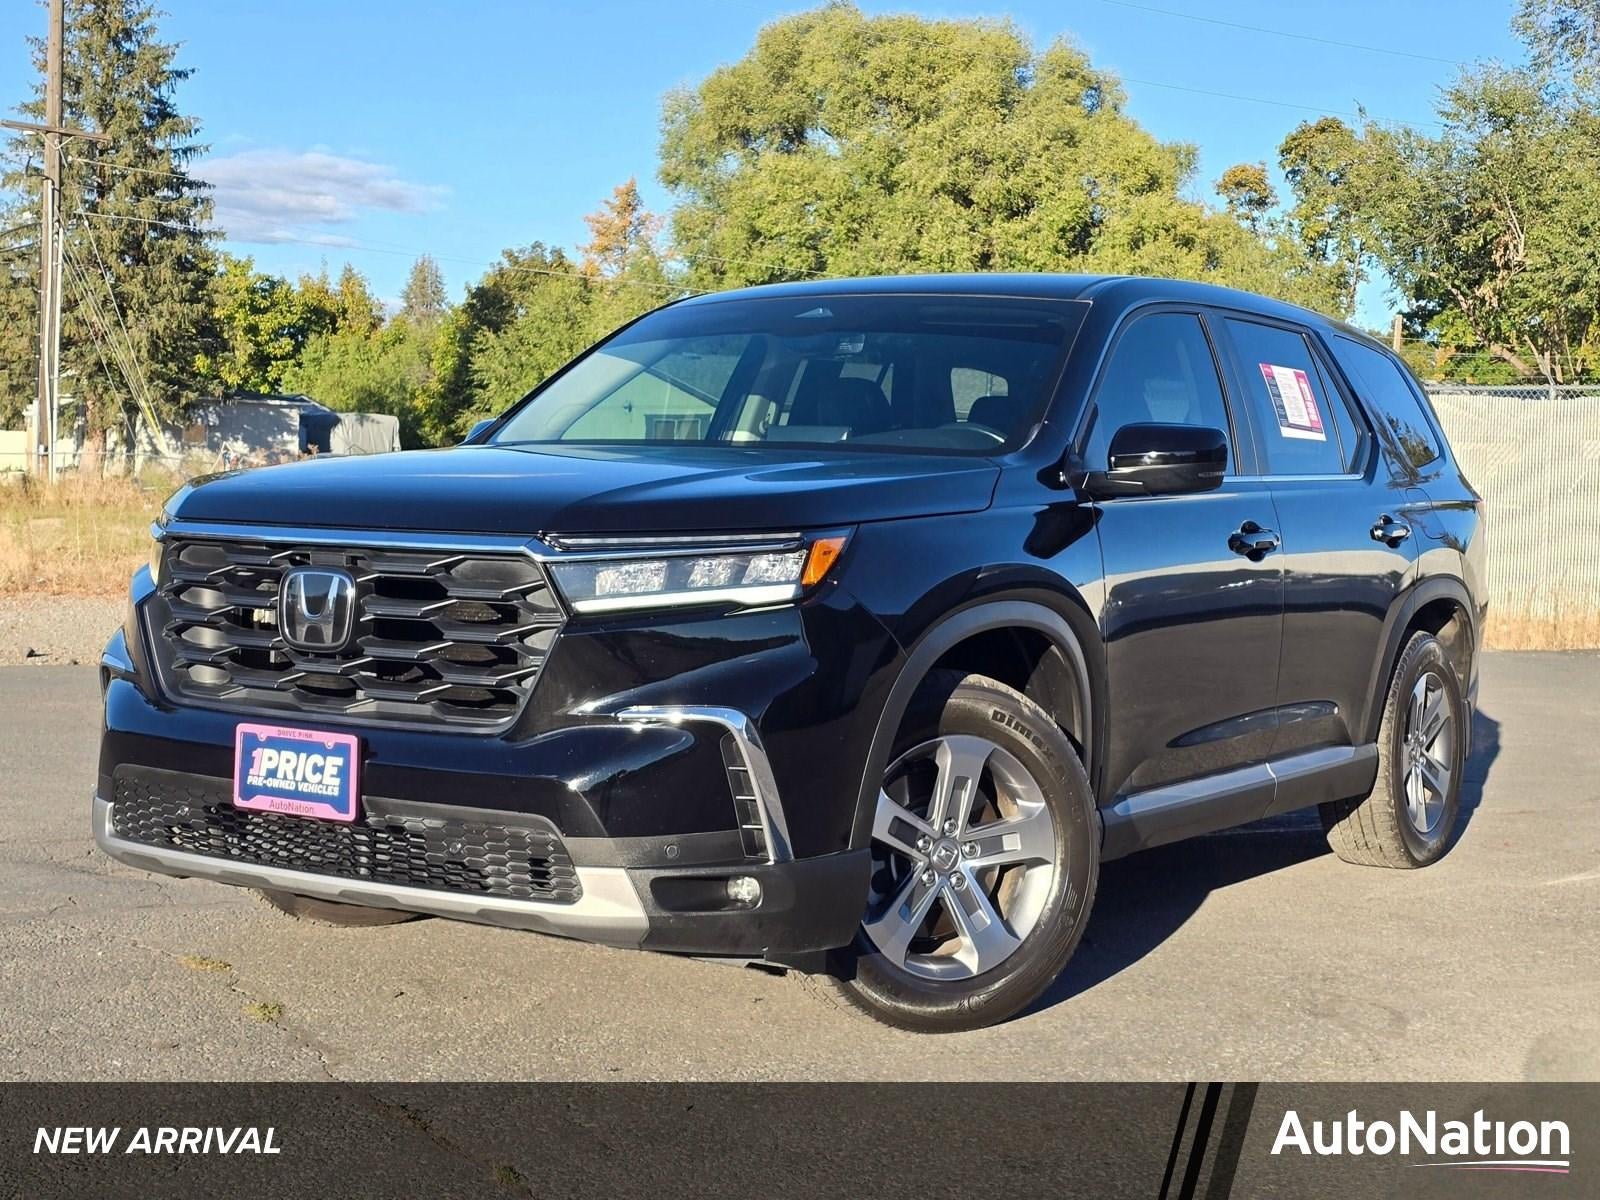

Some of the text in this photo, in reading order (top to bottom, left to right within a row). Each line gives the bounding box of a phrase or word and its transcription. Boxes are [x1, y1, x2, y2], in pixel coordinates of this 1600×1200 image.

[246, 775, 340, 797] PRE-OWNED VEHICLES
[269, 799, 314, 814] AutoNation
